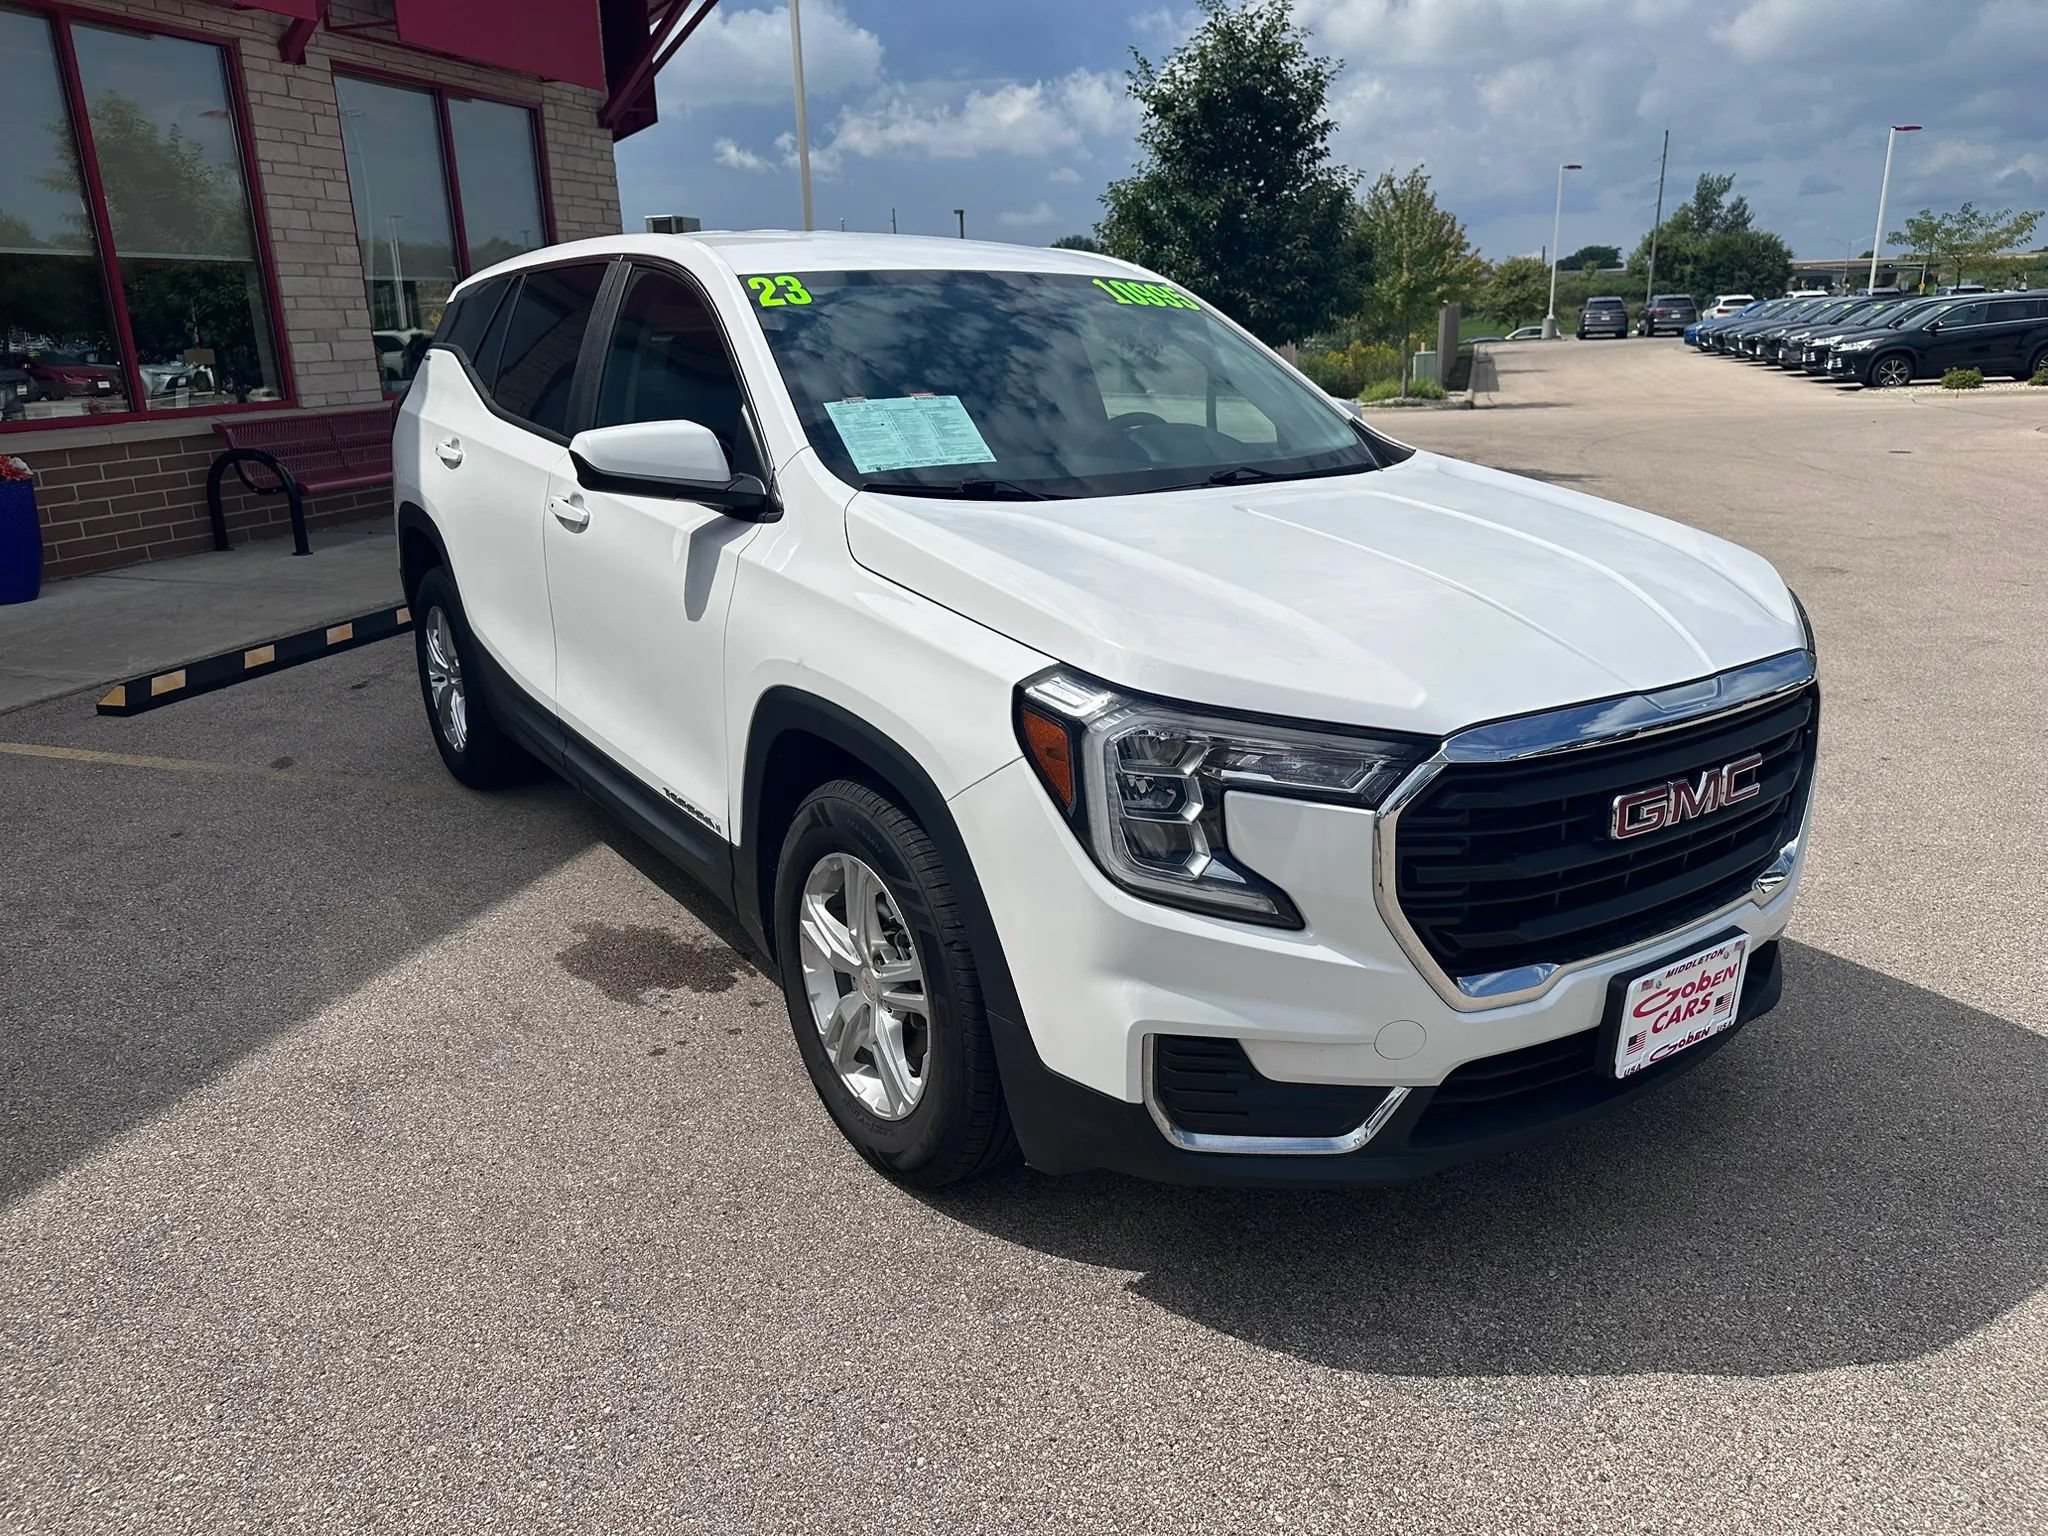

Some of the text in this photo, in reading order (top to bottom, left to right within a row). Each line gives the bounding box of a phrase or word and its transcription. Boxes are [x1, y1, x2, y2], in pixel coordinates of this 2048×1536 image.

[747, 275, 813, 307] 23
[1611, 752, 1763, 840] GMC
[1665, 946, 1726, 979] MIDDLETON
[1651, 991, 1714, 1034] CARS
